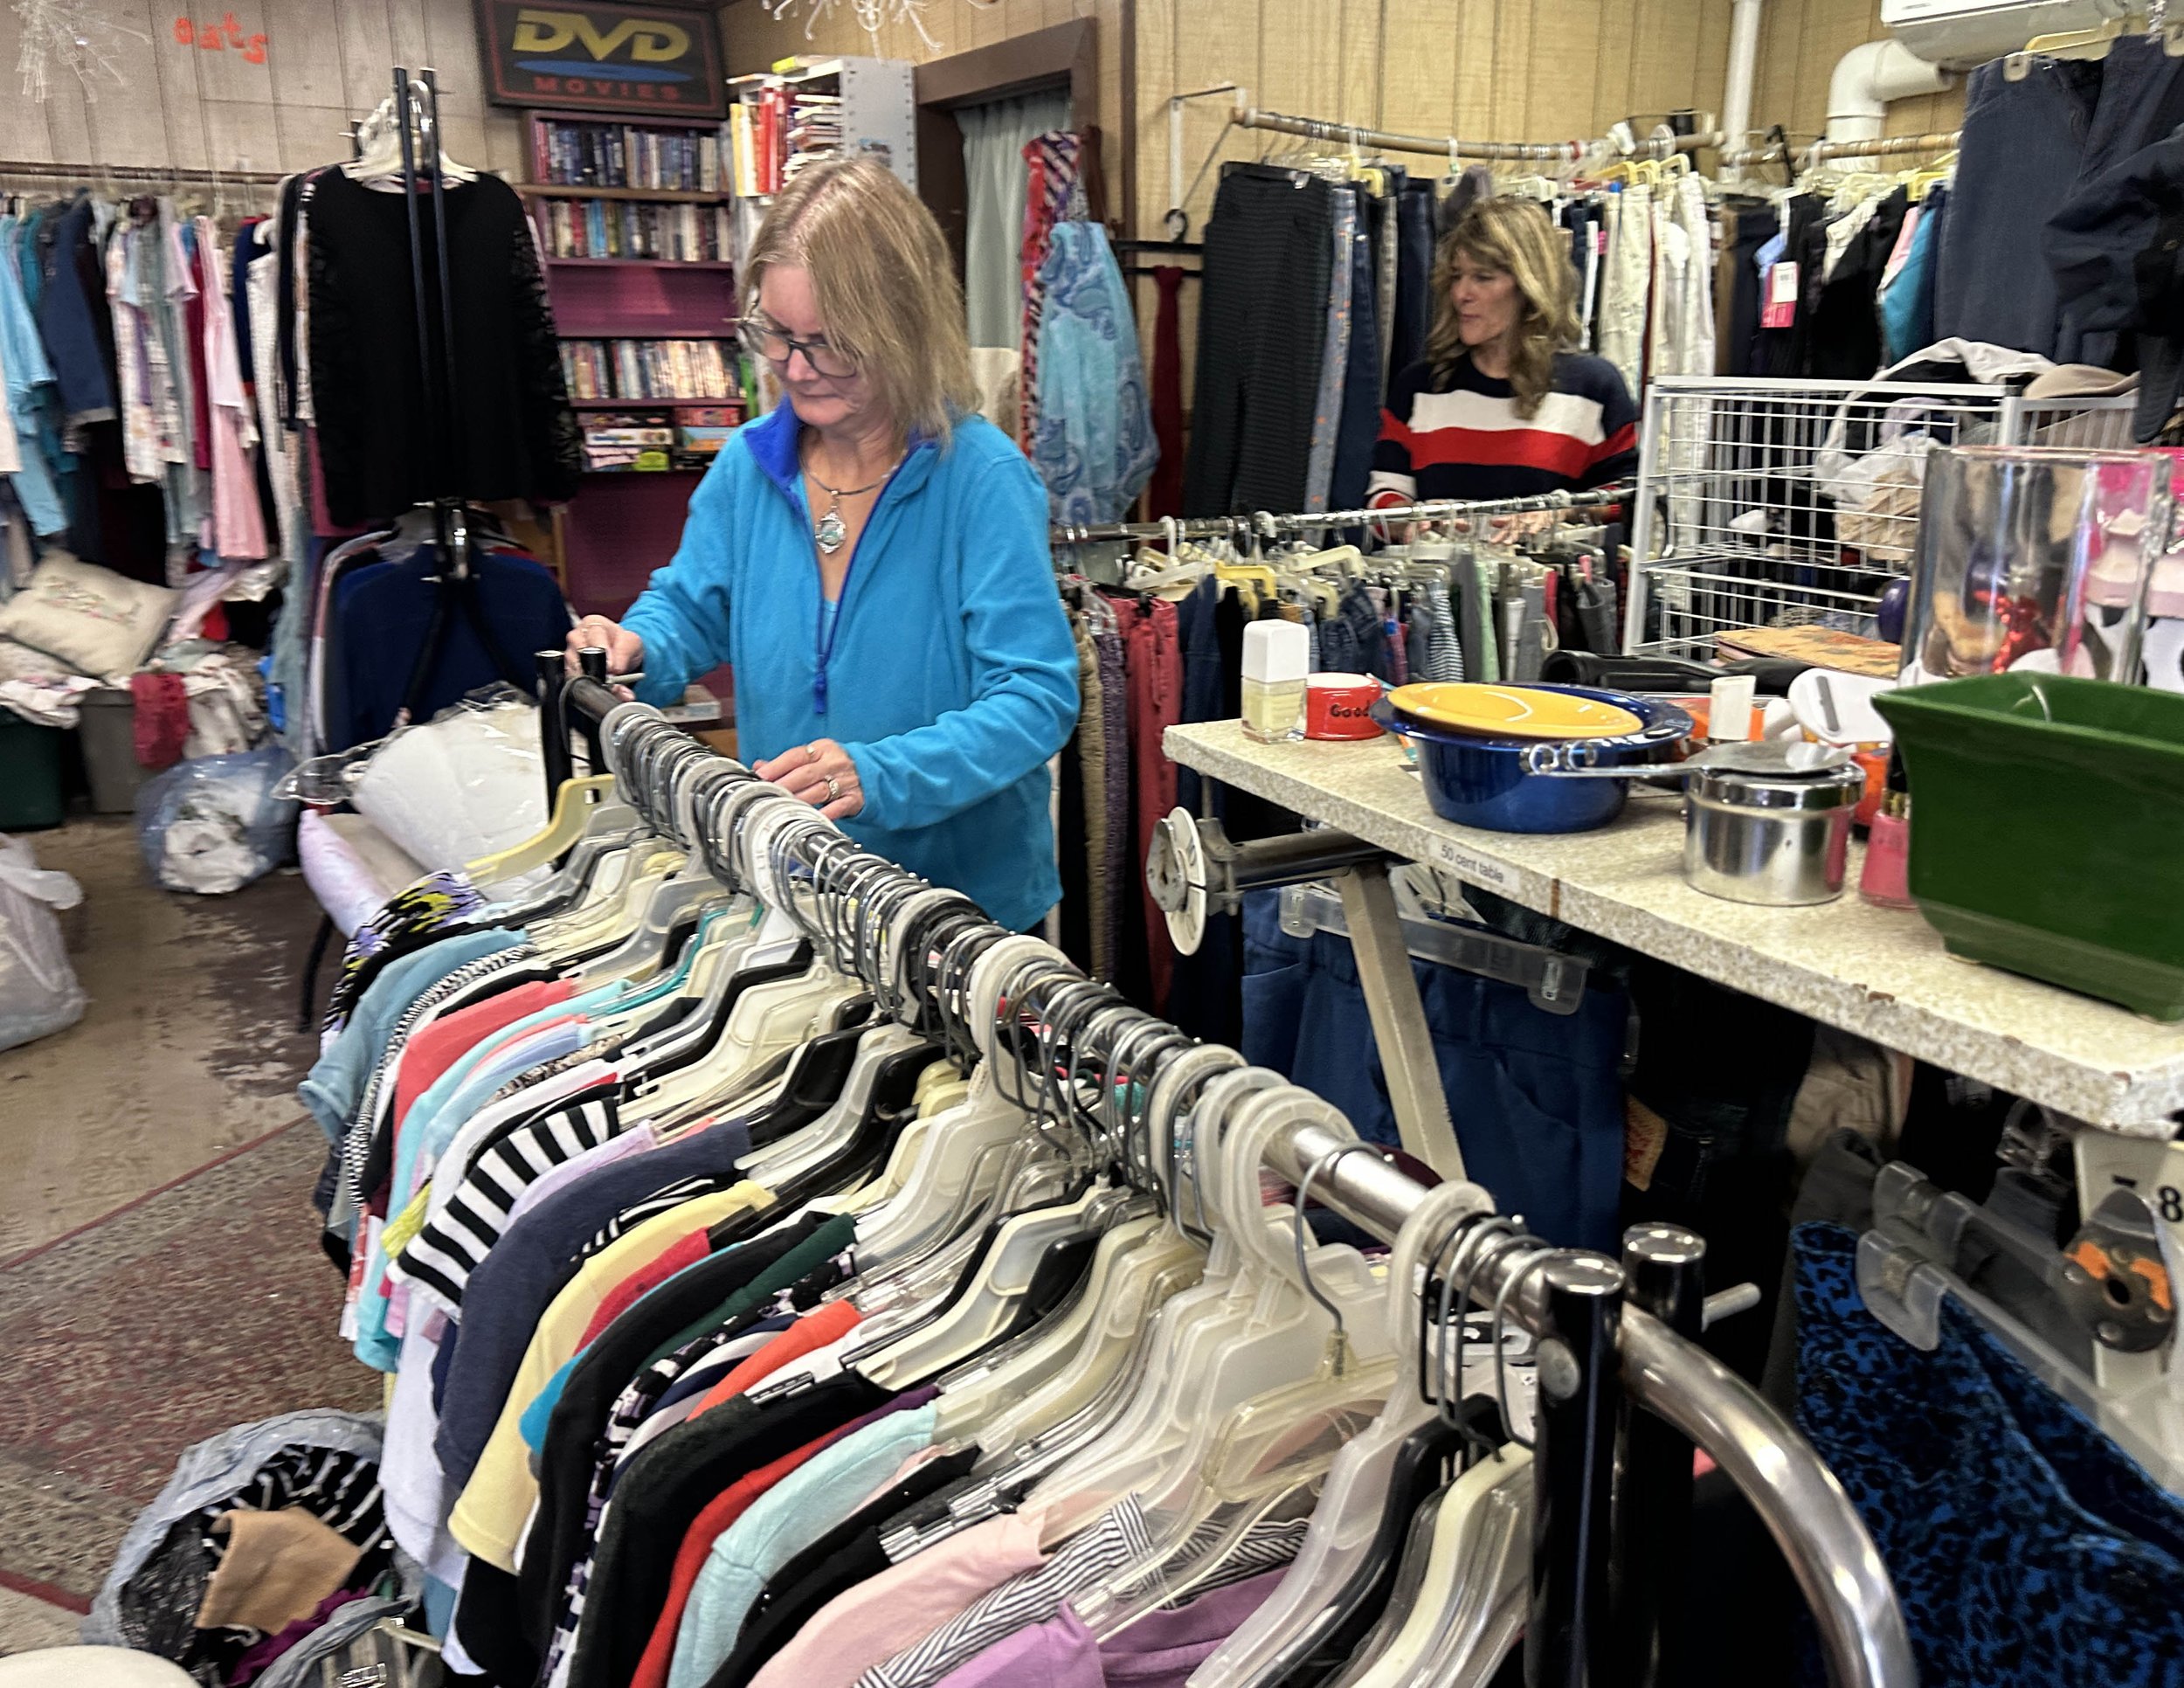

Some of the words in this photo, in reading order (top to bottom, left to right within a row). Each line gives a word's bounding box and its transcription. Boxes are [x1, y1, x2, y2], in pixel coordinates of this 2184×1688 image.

[512, 9, 691, 62] DVD
[534, 76, 680, 100] MOVIES
[1441, 844, 1454, 861] 50
[1455, 854, 1477, 872] cent
[1479, 861, 1503, 882] table
[2159, 1186, 2183, 1222] 8
